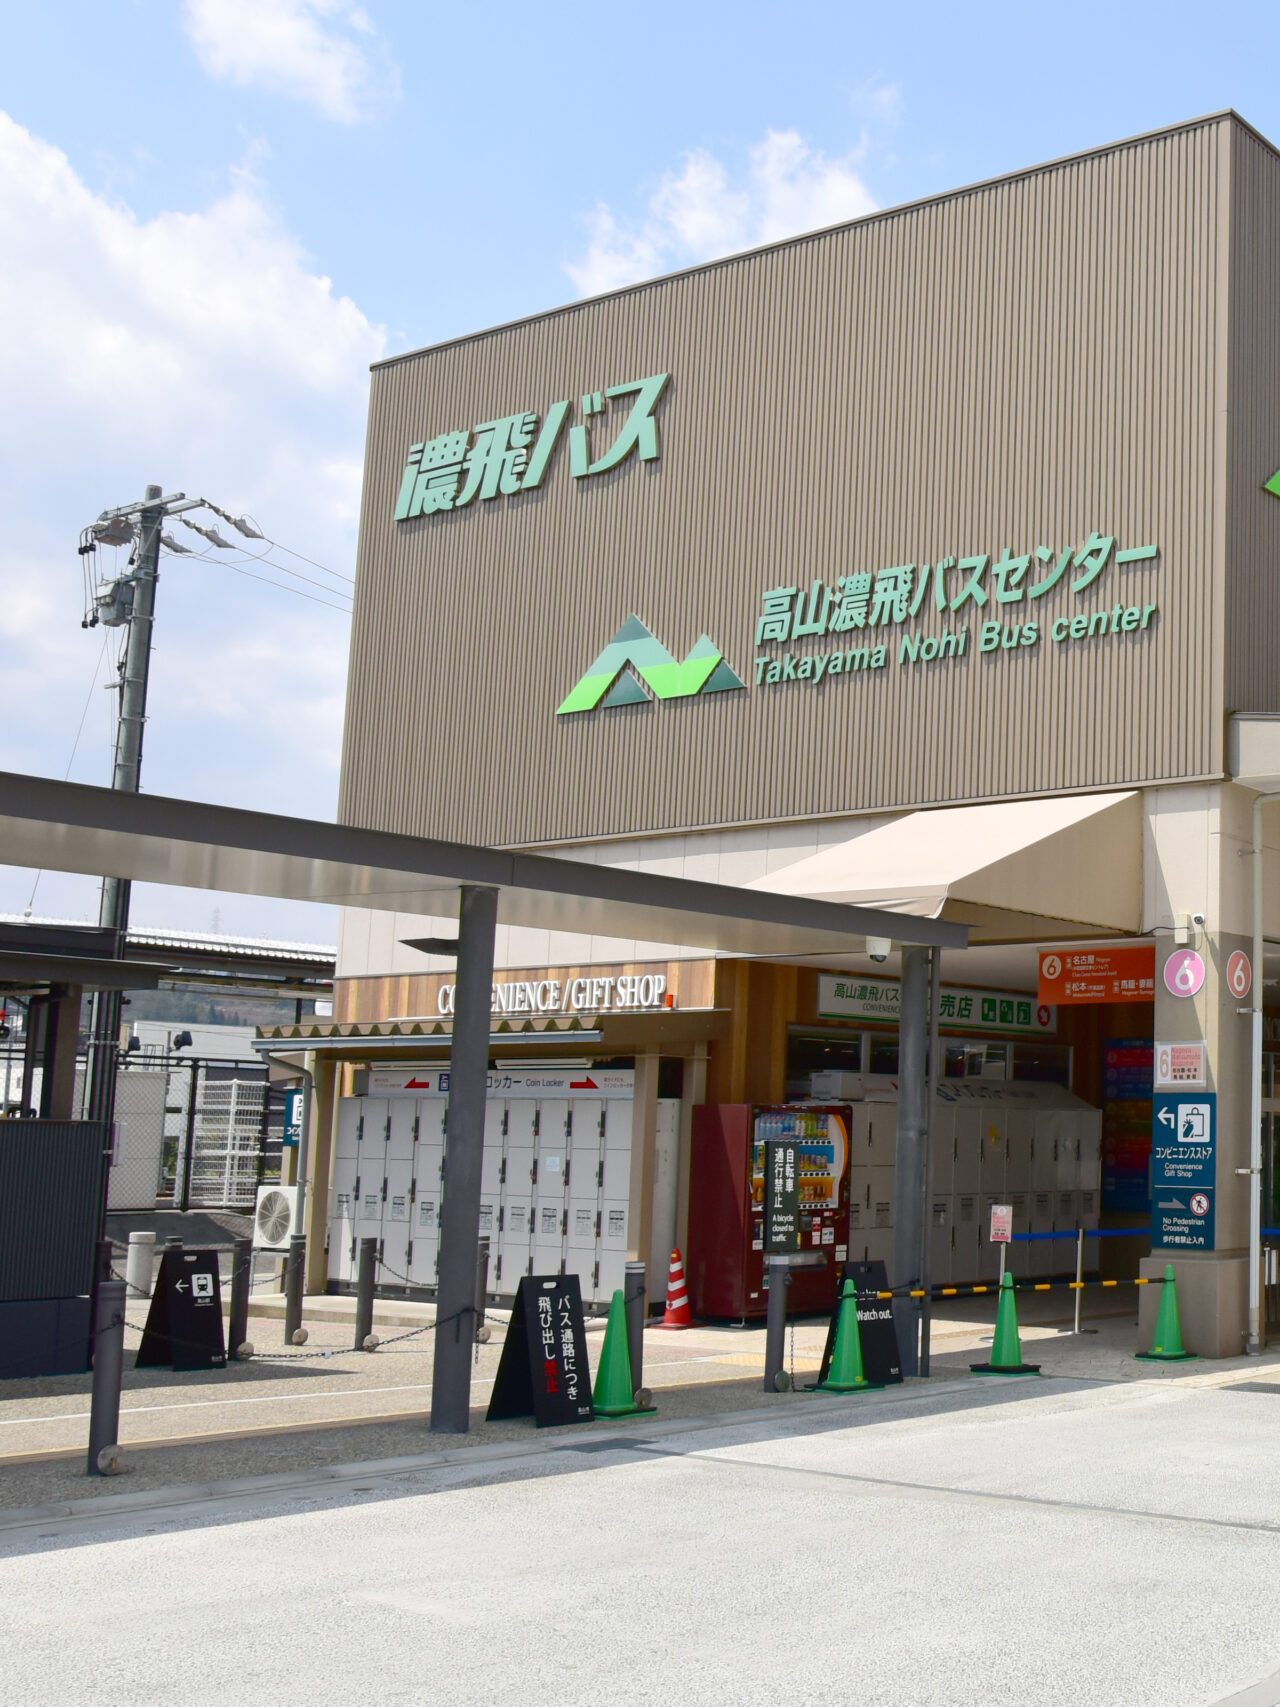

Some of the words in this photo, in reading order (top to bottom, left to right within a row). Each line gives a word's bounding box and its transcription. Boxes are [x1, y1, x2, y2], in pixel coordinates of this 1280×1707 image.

[394, 372, 670, 521] 濃飛バス
[755, 531, 1158, 646] 高山濃飛バスセンター
[754, 643, 886, 685] Takayama
[899, 626, 967, 664] Nohi
[979, 620, 1038, 652] Bus
[1051, 602, 1157, 643] center
[1175, 956, 1194, 990] 6
[1234, 959, 1245, 992] 6
[438, 980, 560, 1014] CENIENCE
[616, 975, 666, 1006] SHOP
[939, 994, 973, 1018] 売店
[1160, 1050, 1169, 1078] 6
[526, 1078, 540, 1086] Coin
[542, 1078, 564, 1086] Locker
[1156, 1147, 1212, 1160] コンビニエンスストア
[774, 1148, 784, 1208] 通行禁止
[785, 1148, 795, 1192] 自転車
[1177, 1170, 1193, 1178] Shop
[772, 1224, 788, 1232] closed
[777, 1214, 794, 1223] bicycle
[1163, 1224, 1189, 1233] Crossing
[1173, 1217, 1205, 1225] Pedestrian
[772, 1234, 787, 1242] traffic
[857, 1308, 878, 1321] Watch
[879, 1309, 893, 1320] out.
[538, 1296, 559, 1393] 飛び出し禁止
[558, 1295, 578, 1400] バス通路につき
